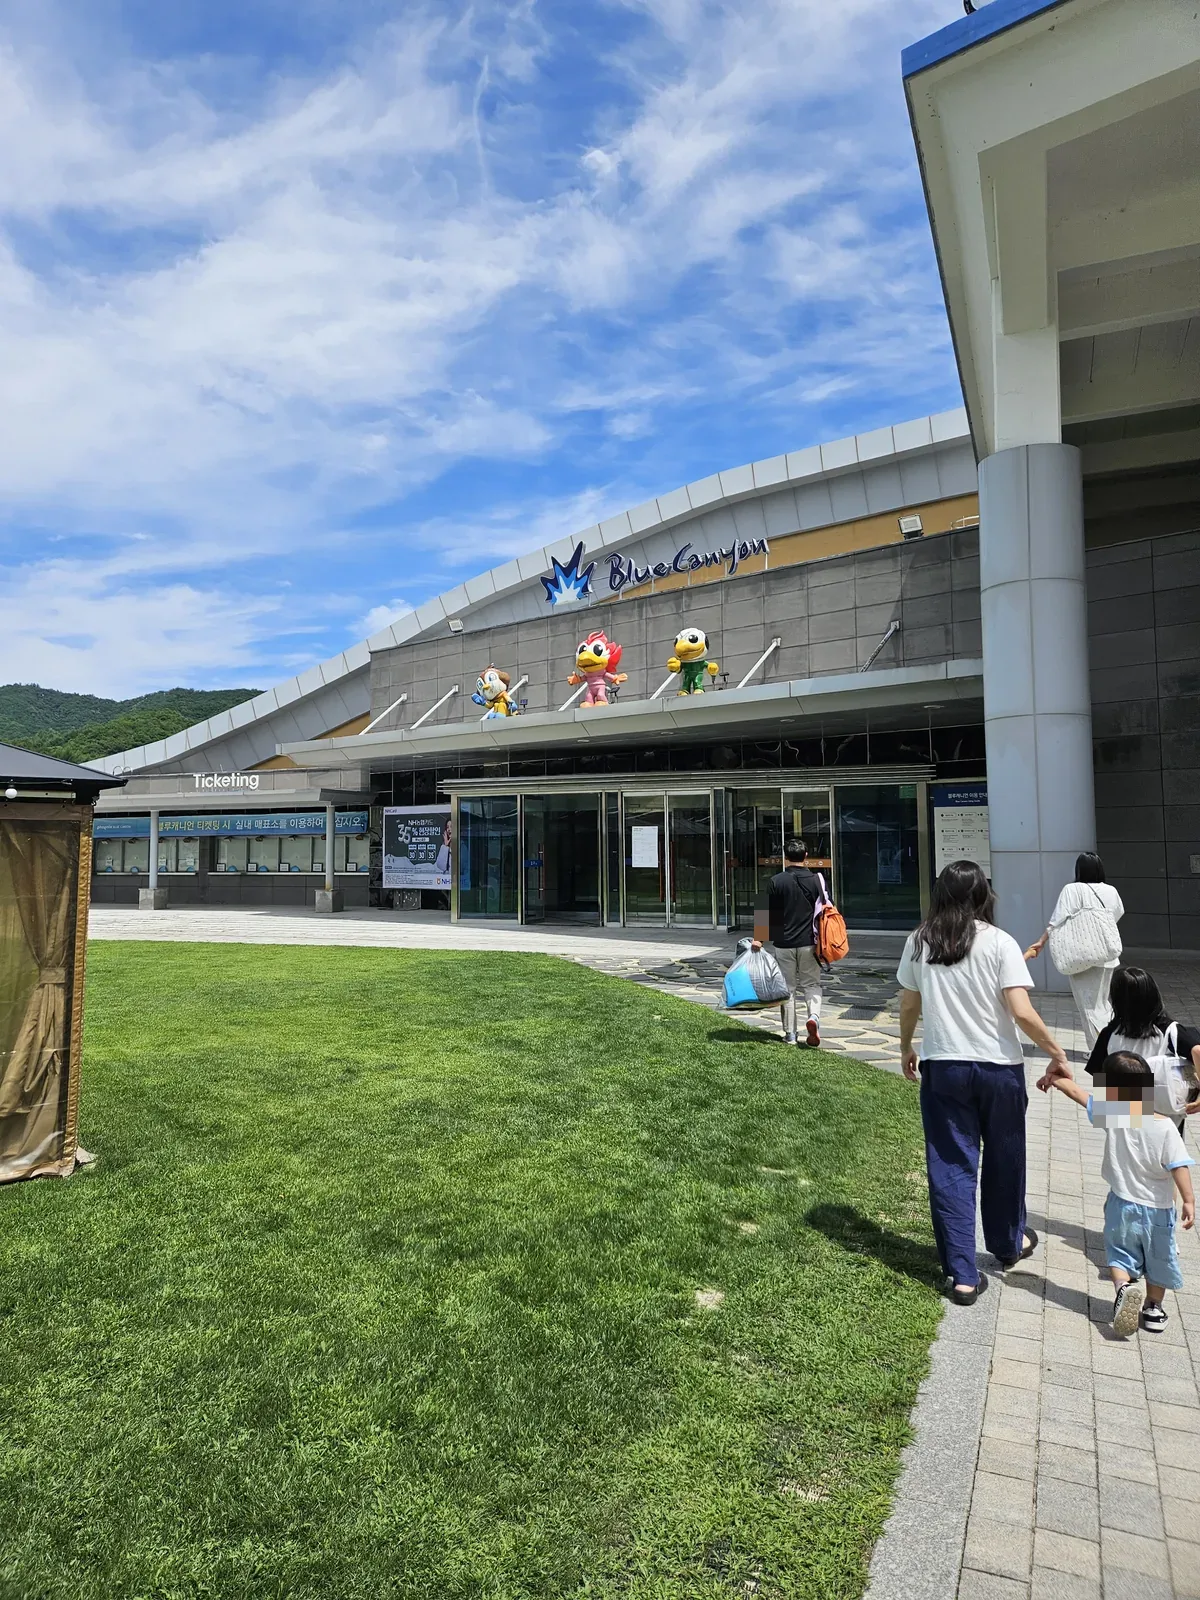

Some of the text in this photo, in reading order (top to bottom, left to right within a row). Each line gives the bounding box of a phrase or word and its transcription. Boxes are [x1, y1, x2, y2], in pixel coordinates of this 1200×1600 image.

[193, 772, 260, 790] Ticketing
[197, 820, 220, 831] 티켓팅
[222, 819, 231, 830] 시
[235, 819, 252, 830] 실내
[254, 819, 287, 829] 매표소를
[289, 817, 324, 829] 이용하여
[335, 816, 364, 828] 십시오.
